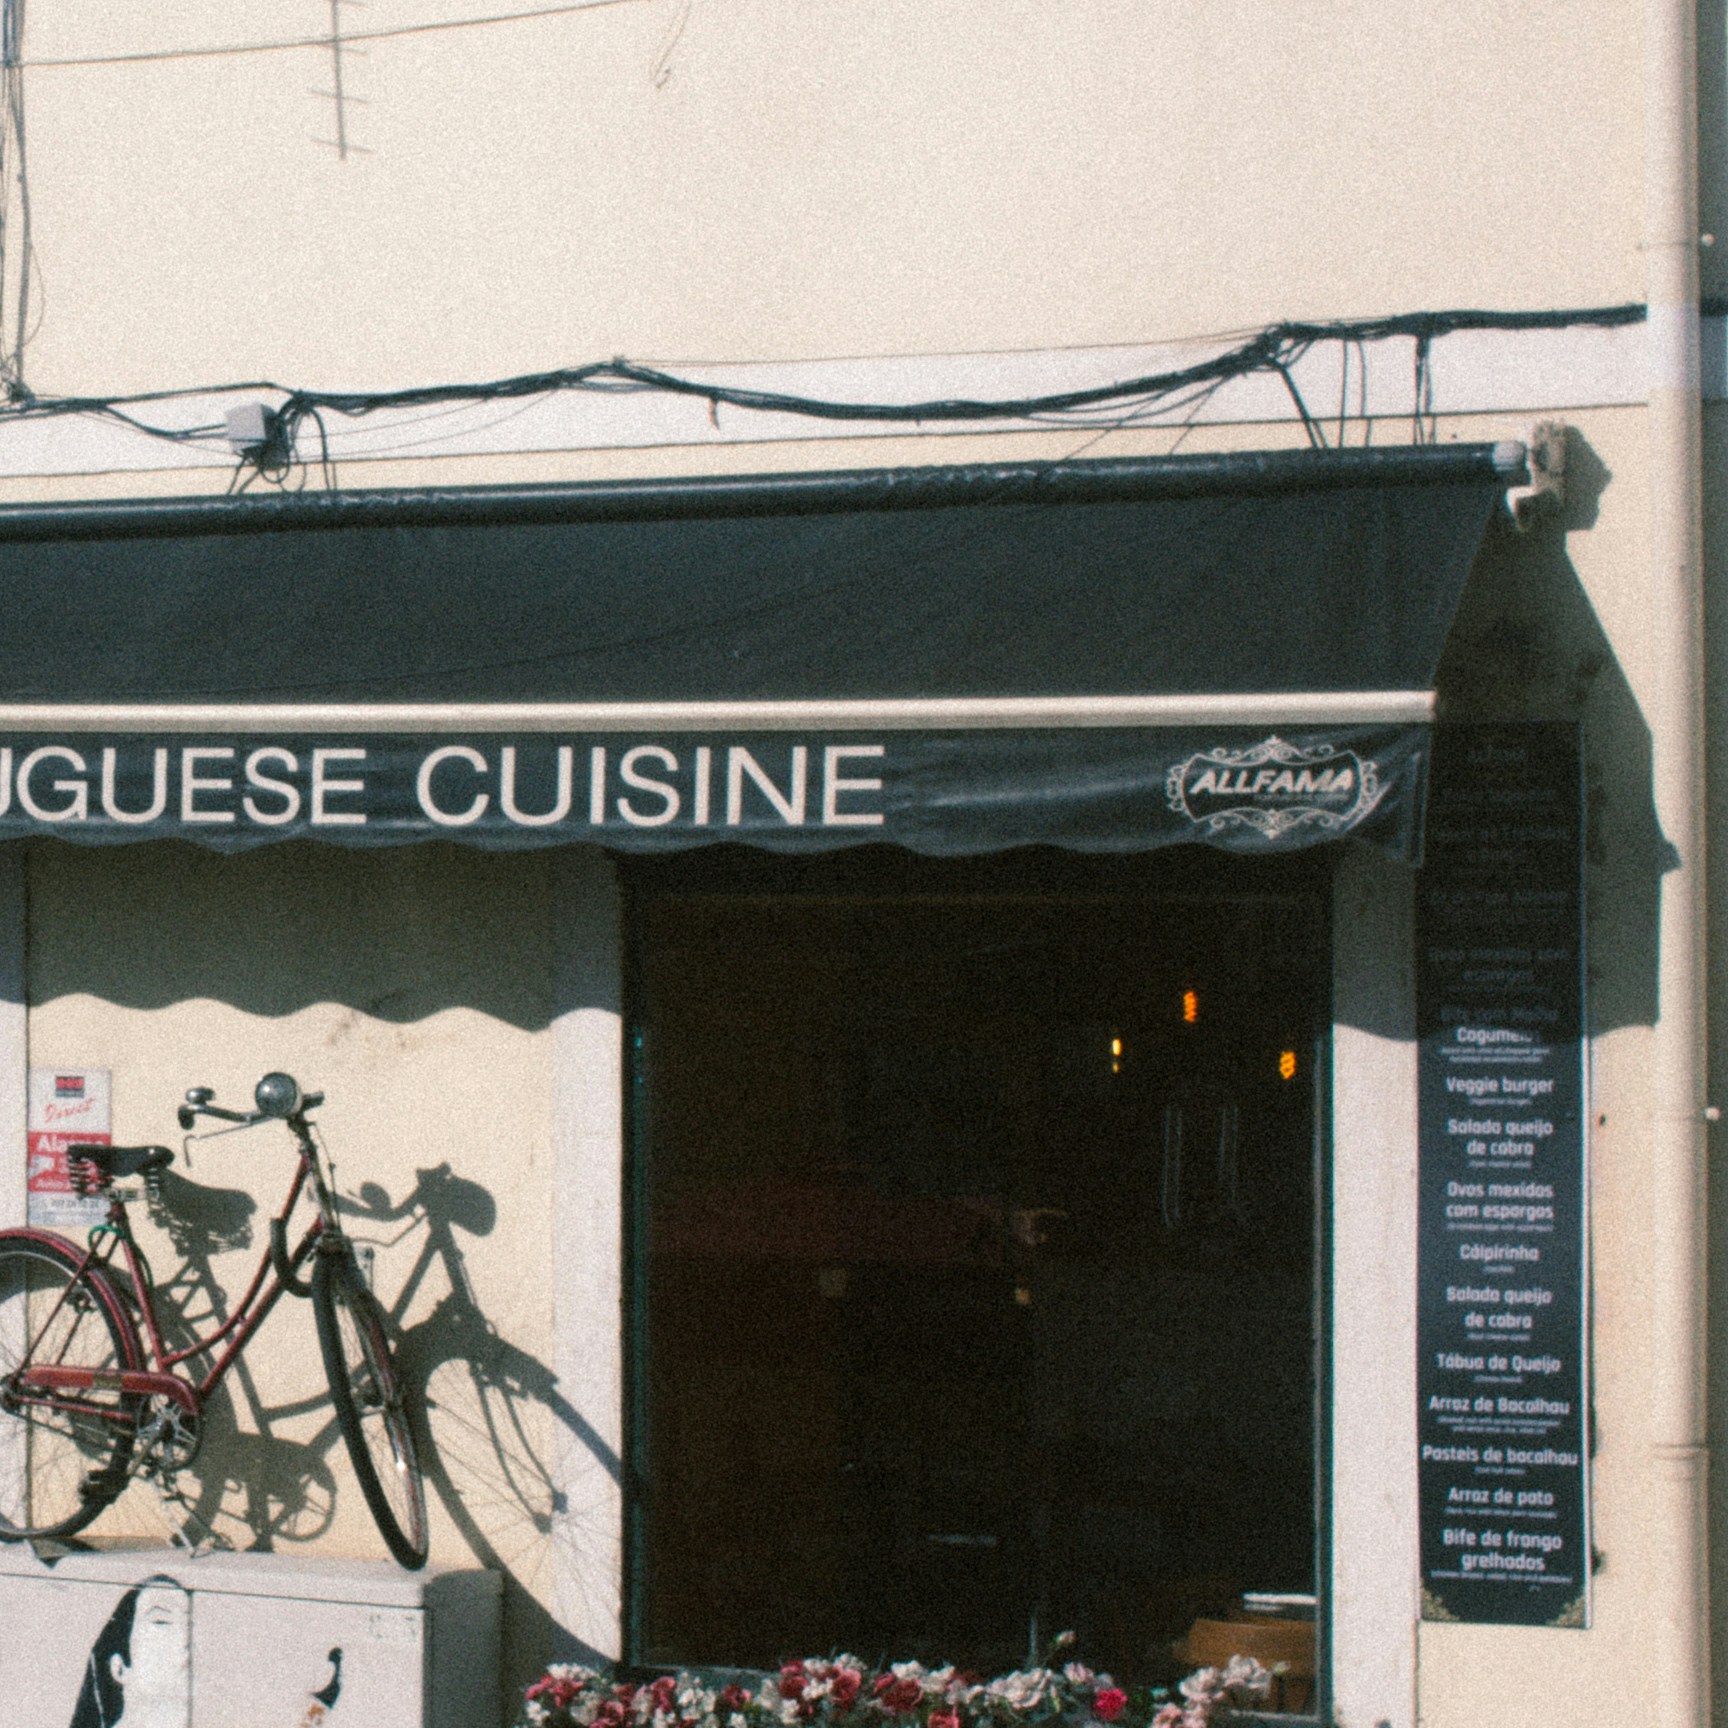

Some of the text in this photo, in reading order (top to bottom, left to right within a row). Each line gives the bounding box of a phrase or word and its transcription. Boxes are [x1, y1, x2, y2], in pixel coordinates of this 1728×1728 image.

[414, 744, 886, 828] CUISINE
[1188, 768, 1354, 794] ALLFAMA
[1445, 1076, 1554, 1096] Veggie burger
[1447, 1117, 1554, 1138] Salada queijo
[1466, 1138, 1535, 1156] de cabra
[1447, 1180, 1554, 1199] Ovos mexidos
[1446, 1204, 1554, 1222] com espargos
[1446, 1285, 1553, 1307] Salada queijo
[1464, 1310, 1533, 1329] de cabra
[1436, 1351, 1562, 1375] Tábua de Queijo
[1428, 1394, 1571, 1415] Arroz de Bacalhau
[1421, 1444, 1579, 1466] Pasteis de bacalhau
[1447, 1486, 1554, 1507] Arroz de pato
[1442, 1528, 1563, 1552] Bife de frango
[1461, 1551, 1546, 1571] grelhados
